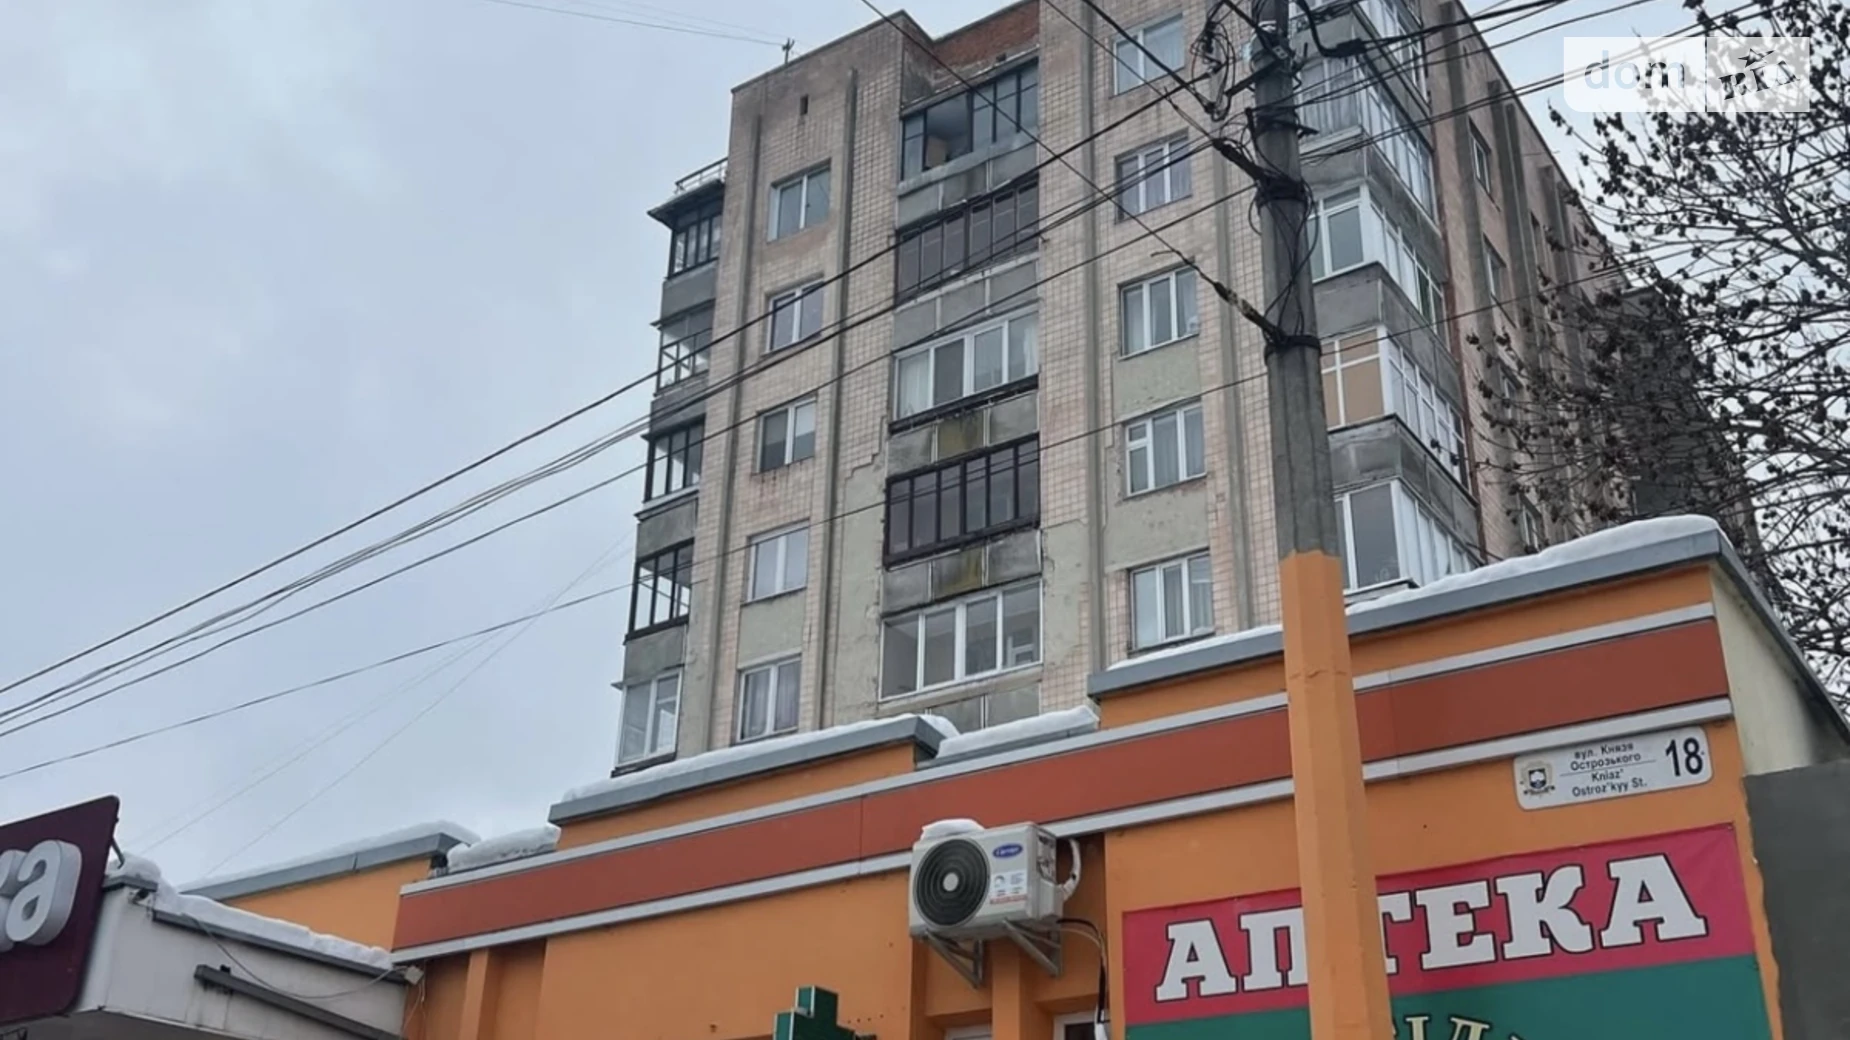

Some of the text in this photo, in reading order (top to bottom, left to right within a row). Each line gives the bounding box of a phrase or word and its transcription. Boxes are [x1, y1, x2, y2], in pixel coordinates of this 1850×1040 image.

[1570, 751, 1641, 772] Острозького
[1573, 742, 1634, 761] вул. Князя
[1665, 737, 1703, 777] 18
[1632, 777, 1648, 788] St.
